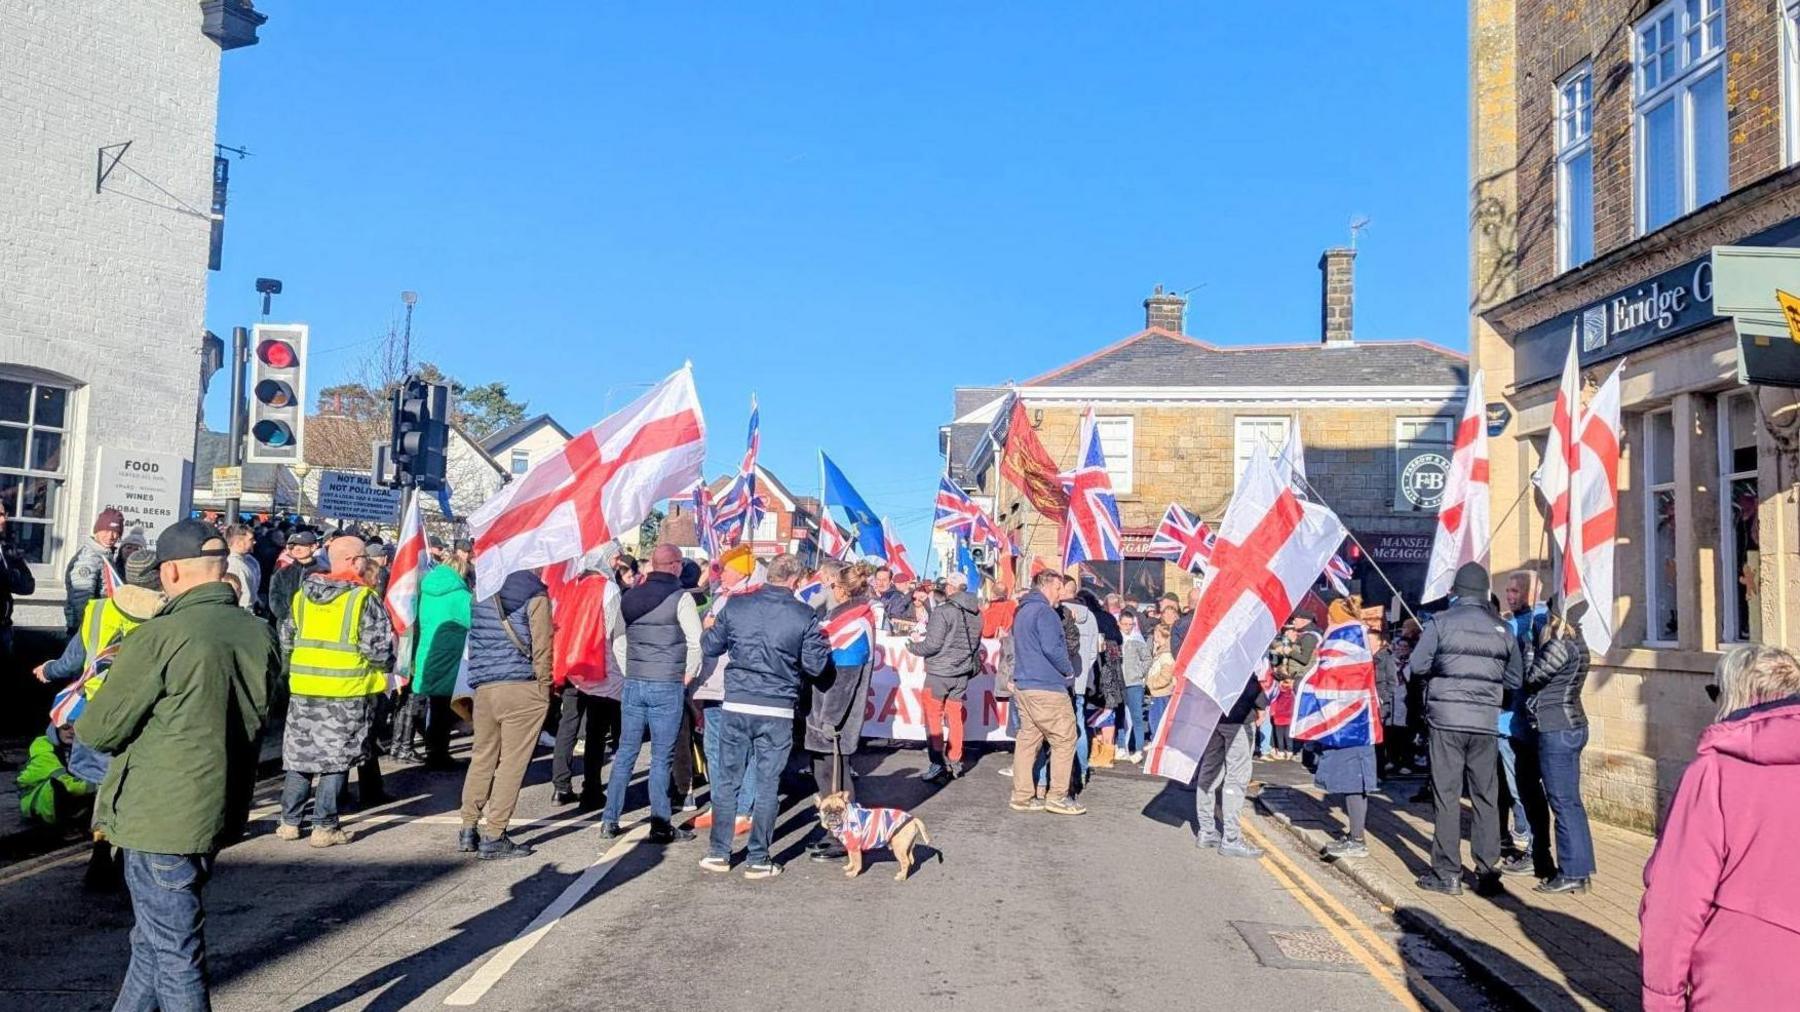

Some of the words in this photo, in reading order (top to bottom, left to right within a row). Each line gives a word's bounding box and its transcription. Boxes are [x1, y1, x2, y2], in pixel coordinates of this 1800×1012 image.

[1611, 281, 1686, 335] Eridge
[124, 460, 159, 473] FOOD
[337, 474, 355, 483] NOT
[329, 483, 347, 492] NOT
[349, 486, 392, 497] POLITICAL
[126, 492, 154, 501] WINES
[143, 507, 171, 516] BEERS
